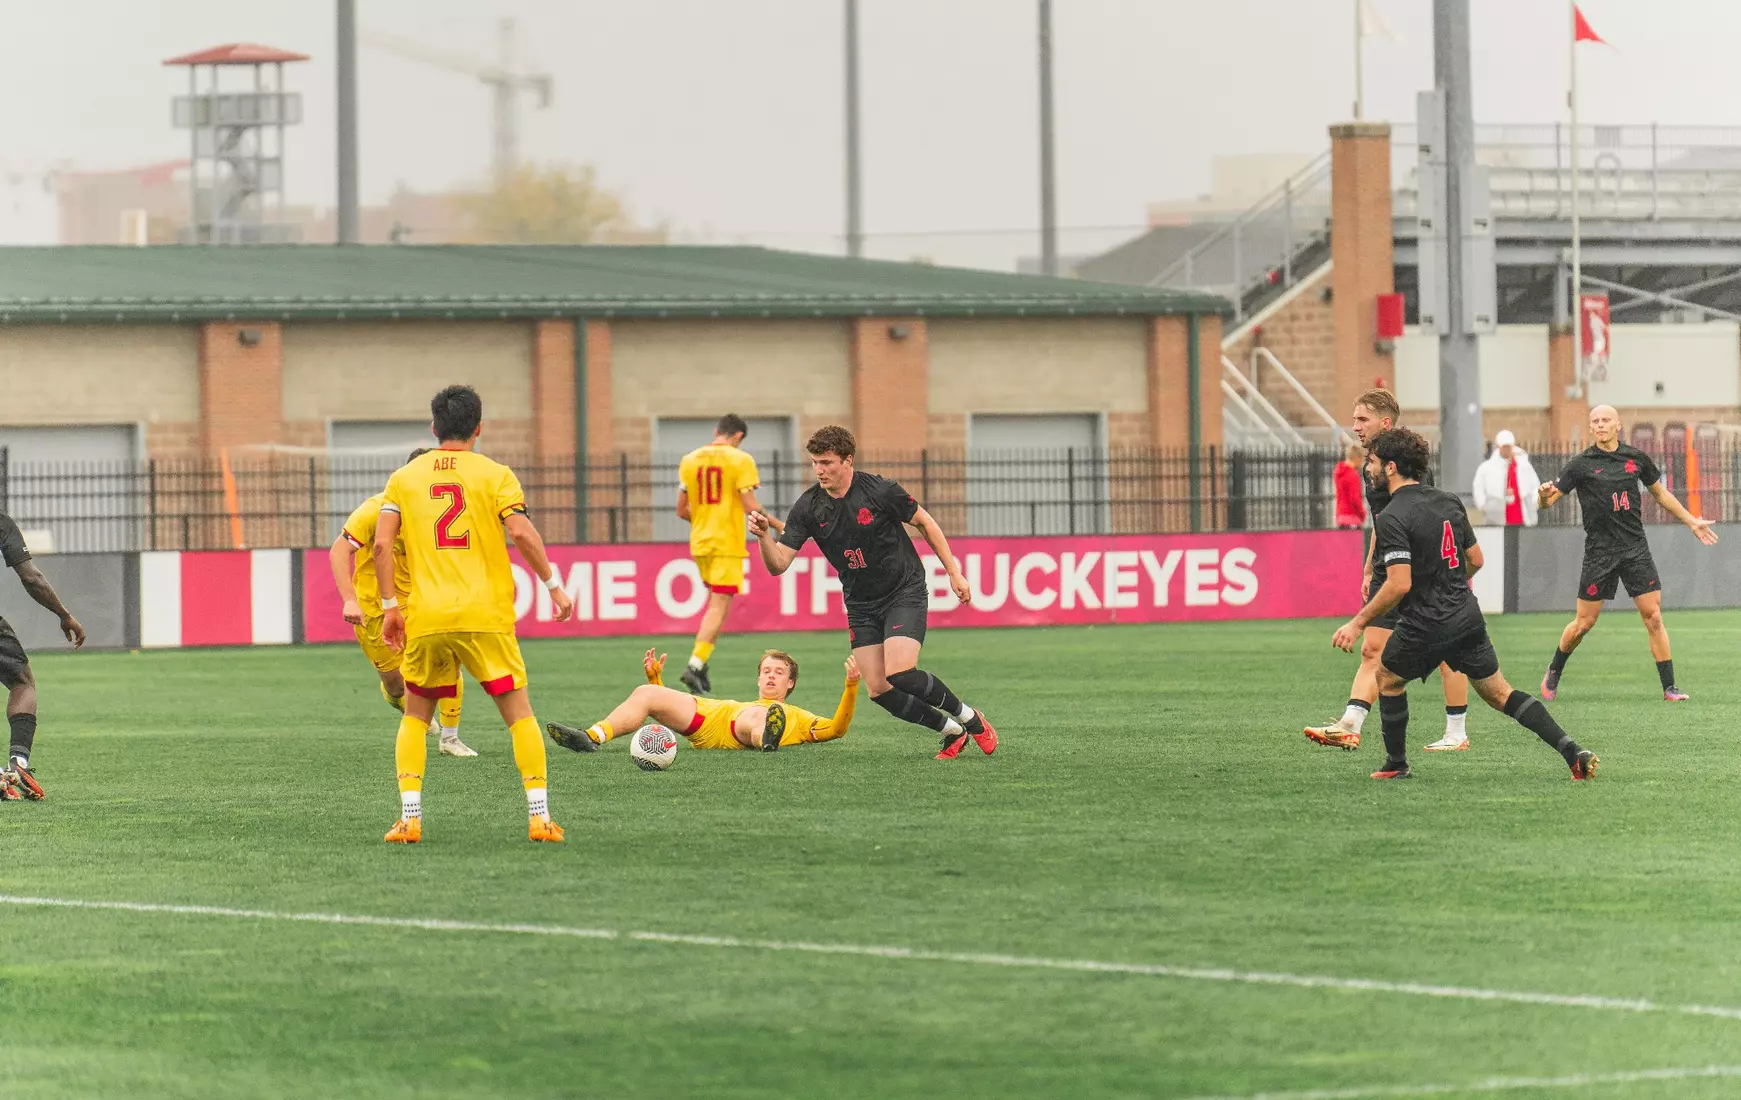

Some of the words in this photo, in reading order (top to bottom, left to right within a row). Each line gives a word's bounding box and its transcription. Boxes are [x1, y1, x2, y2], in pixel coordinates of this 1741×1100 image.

[433, 457, 457, 471] ABE
[696, 466, 722, 504] 10
[1612, 491, 1630, 512] 14
[430, 483, 470, 550] 2
[844, 548, 867, 569] 31
[1441, 520, 1459, 569] 4
[655, 557, 750, 619] O
[779, 556, 848, 616] TH
[925, 547, 1258, 612] BUCKEYES
